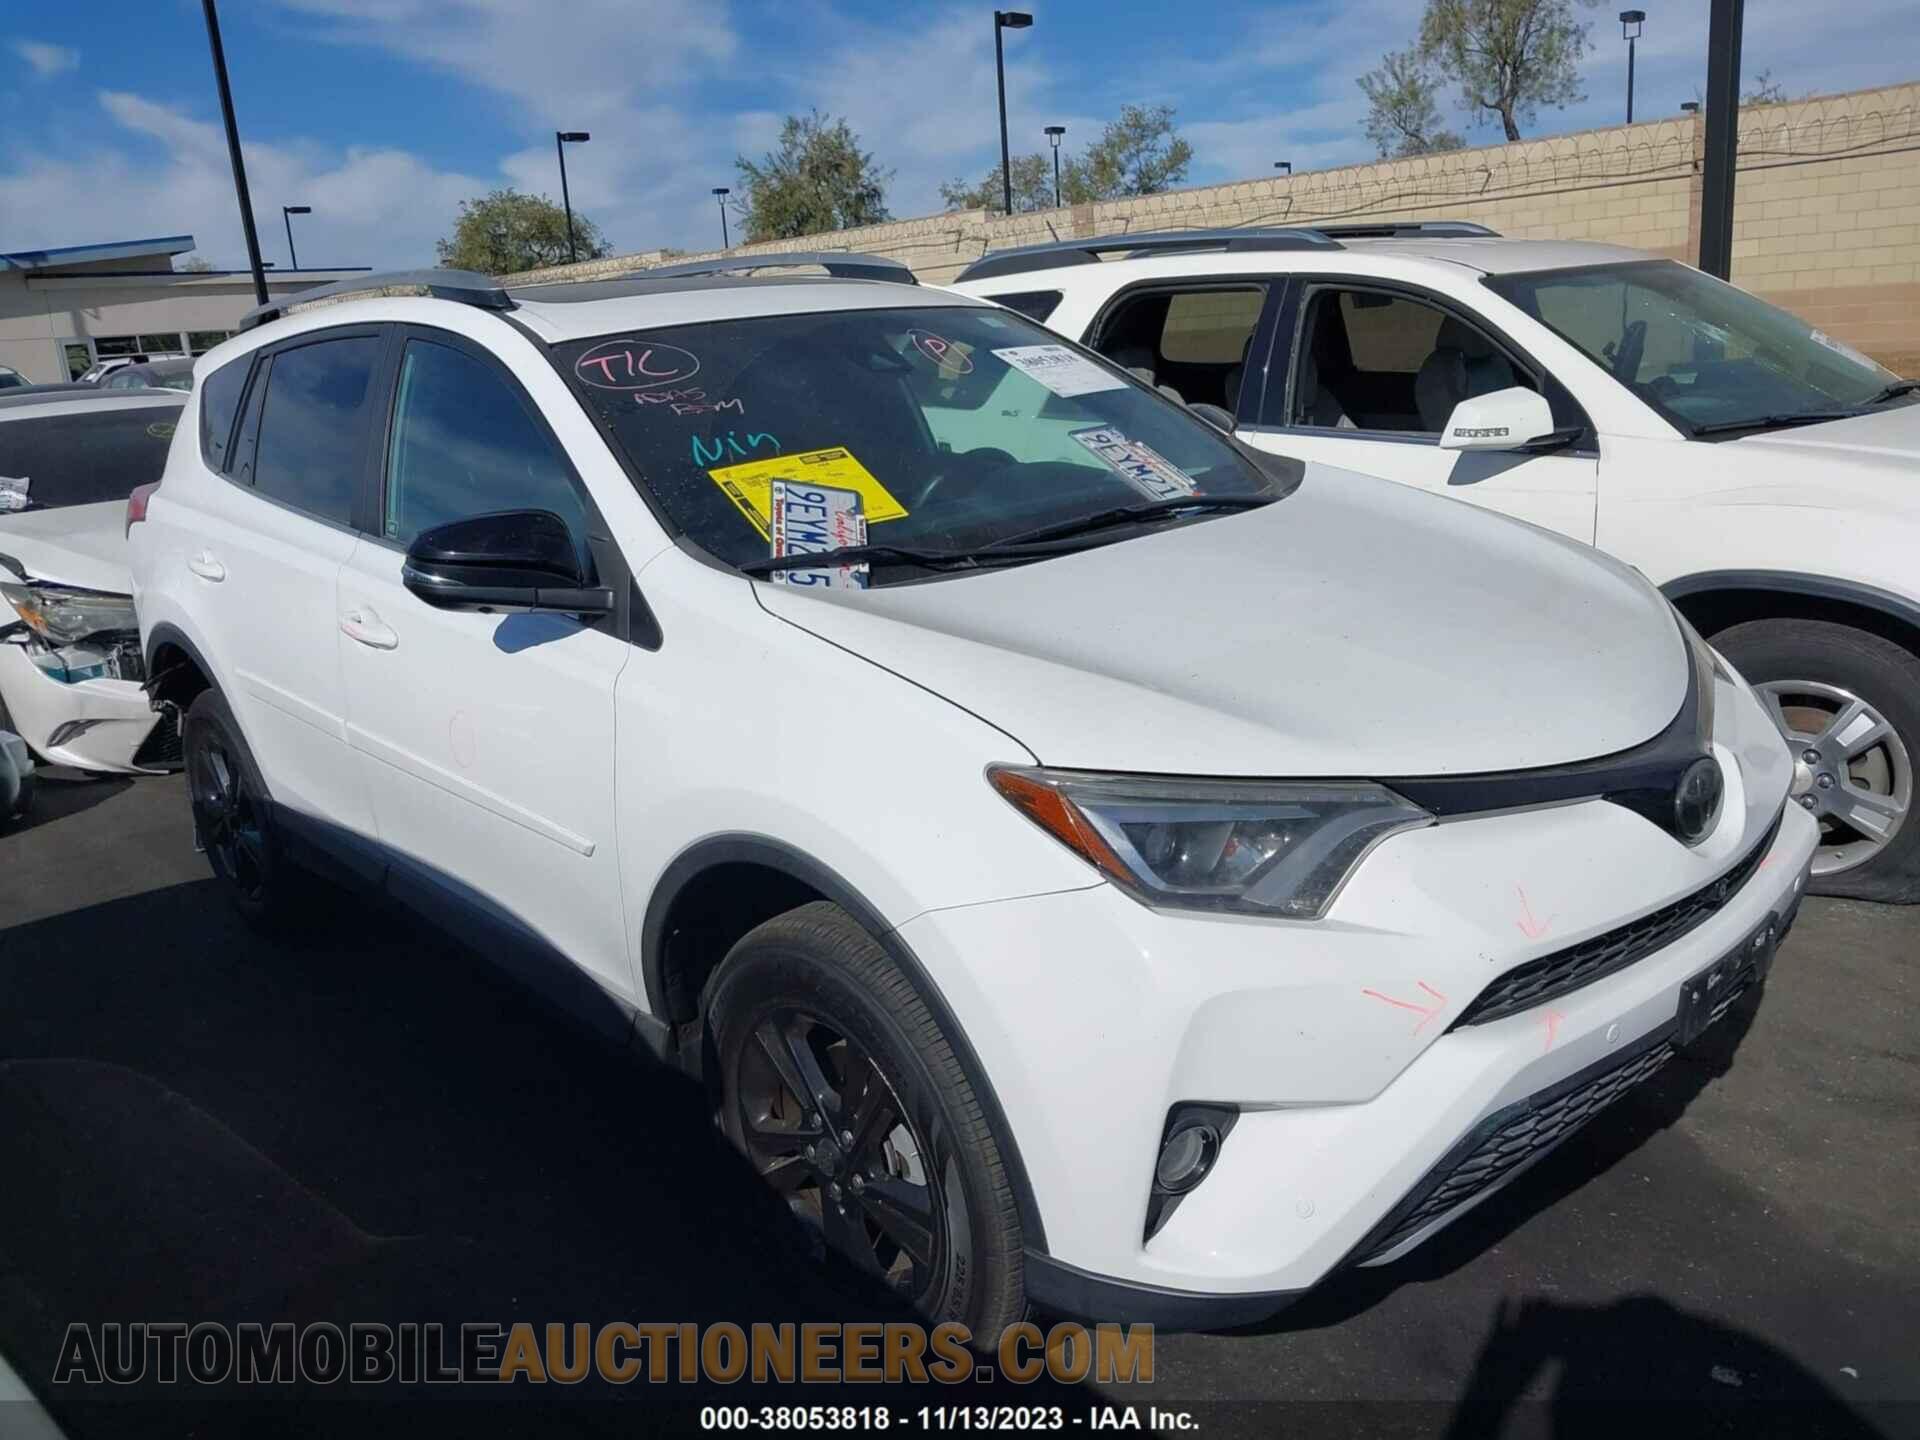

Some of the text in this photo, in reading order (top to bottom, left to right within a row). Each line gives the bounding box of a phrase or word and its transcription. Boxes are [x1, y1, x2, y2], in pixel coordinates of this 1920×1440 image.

[1082, 433, 1180, 496] 9EYM21
[774, 498, 785, 525] Toyota
[774, 526, 785, 536] of
[785, 486, 832, 588] 9EYM25
